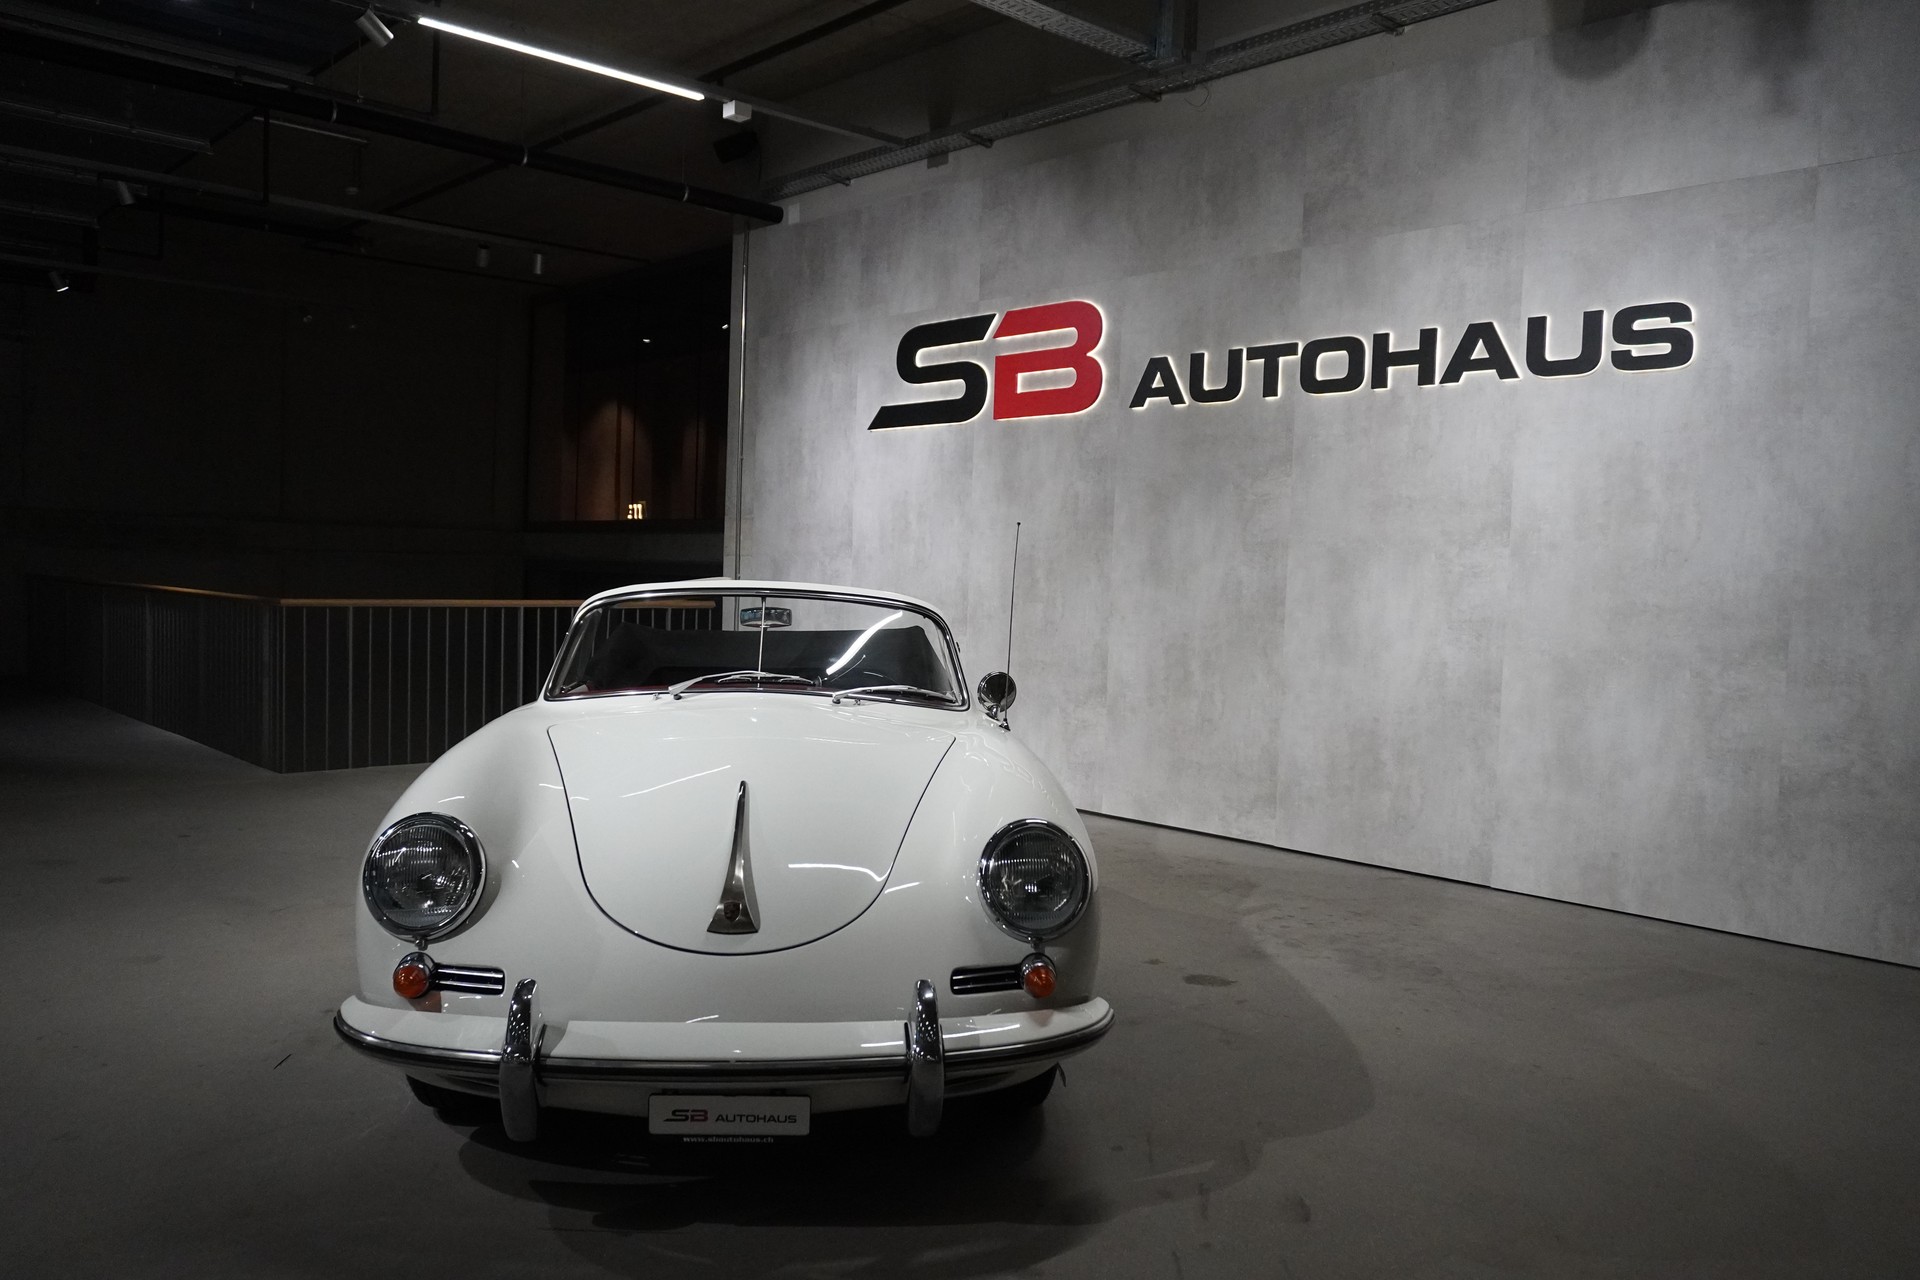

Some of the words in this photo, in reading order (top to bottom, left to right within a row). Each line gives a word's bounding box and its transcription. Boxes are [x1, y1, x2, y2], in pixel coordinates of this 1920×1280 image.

[868, 301, 1103, 430] SB
[1130, 301, 1695, 410] AUTOHAUS
[663, 1109, 708, 1122] SB
[715, 1114, 797, 1124] AUTOHAUS
